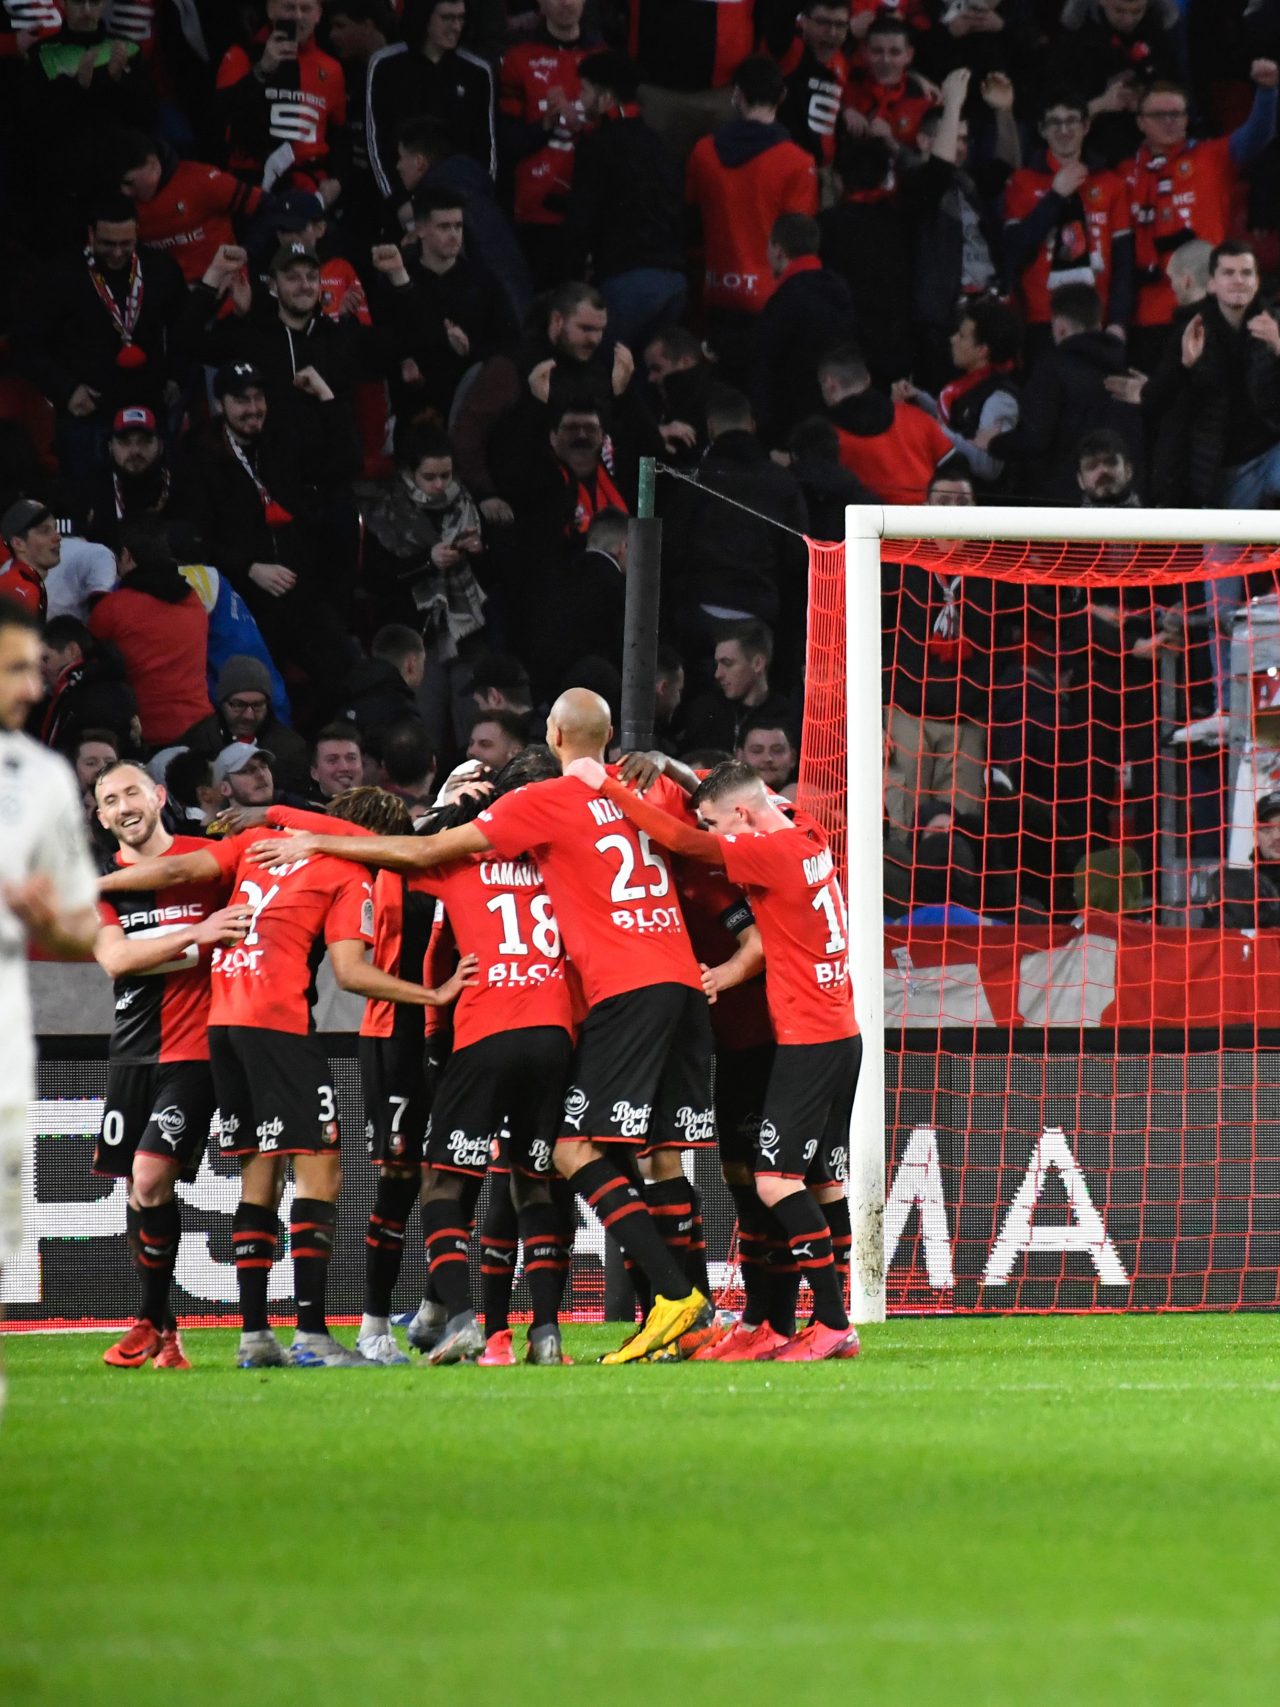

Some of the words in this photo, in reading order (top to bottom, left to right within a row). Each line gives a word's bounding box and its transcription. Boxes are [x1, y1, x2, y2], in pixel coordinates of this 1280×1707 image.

[479, 861, 544, 887] CAMAVI
[594, 830, 670, 904] 25
[118, 903, 205, 929] SAMSIC
[485, 892, 562, 959] 18
[611, 906, 681, 930] BLOT
[317, 1085, 335, 1121] 3
[388, 1095, 409, 1132] 7
[453, 1150, 487, 1166] Cola
